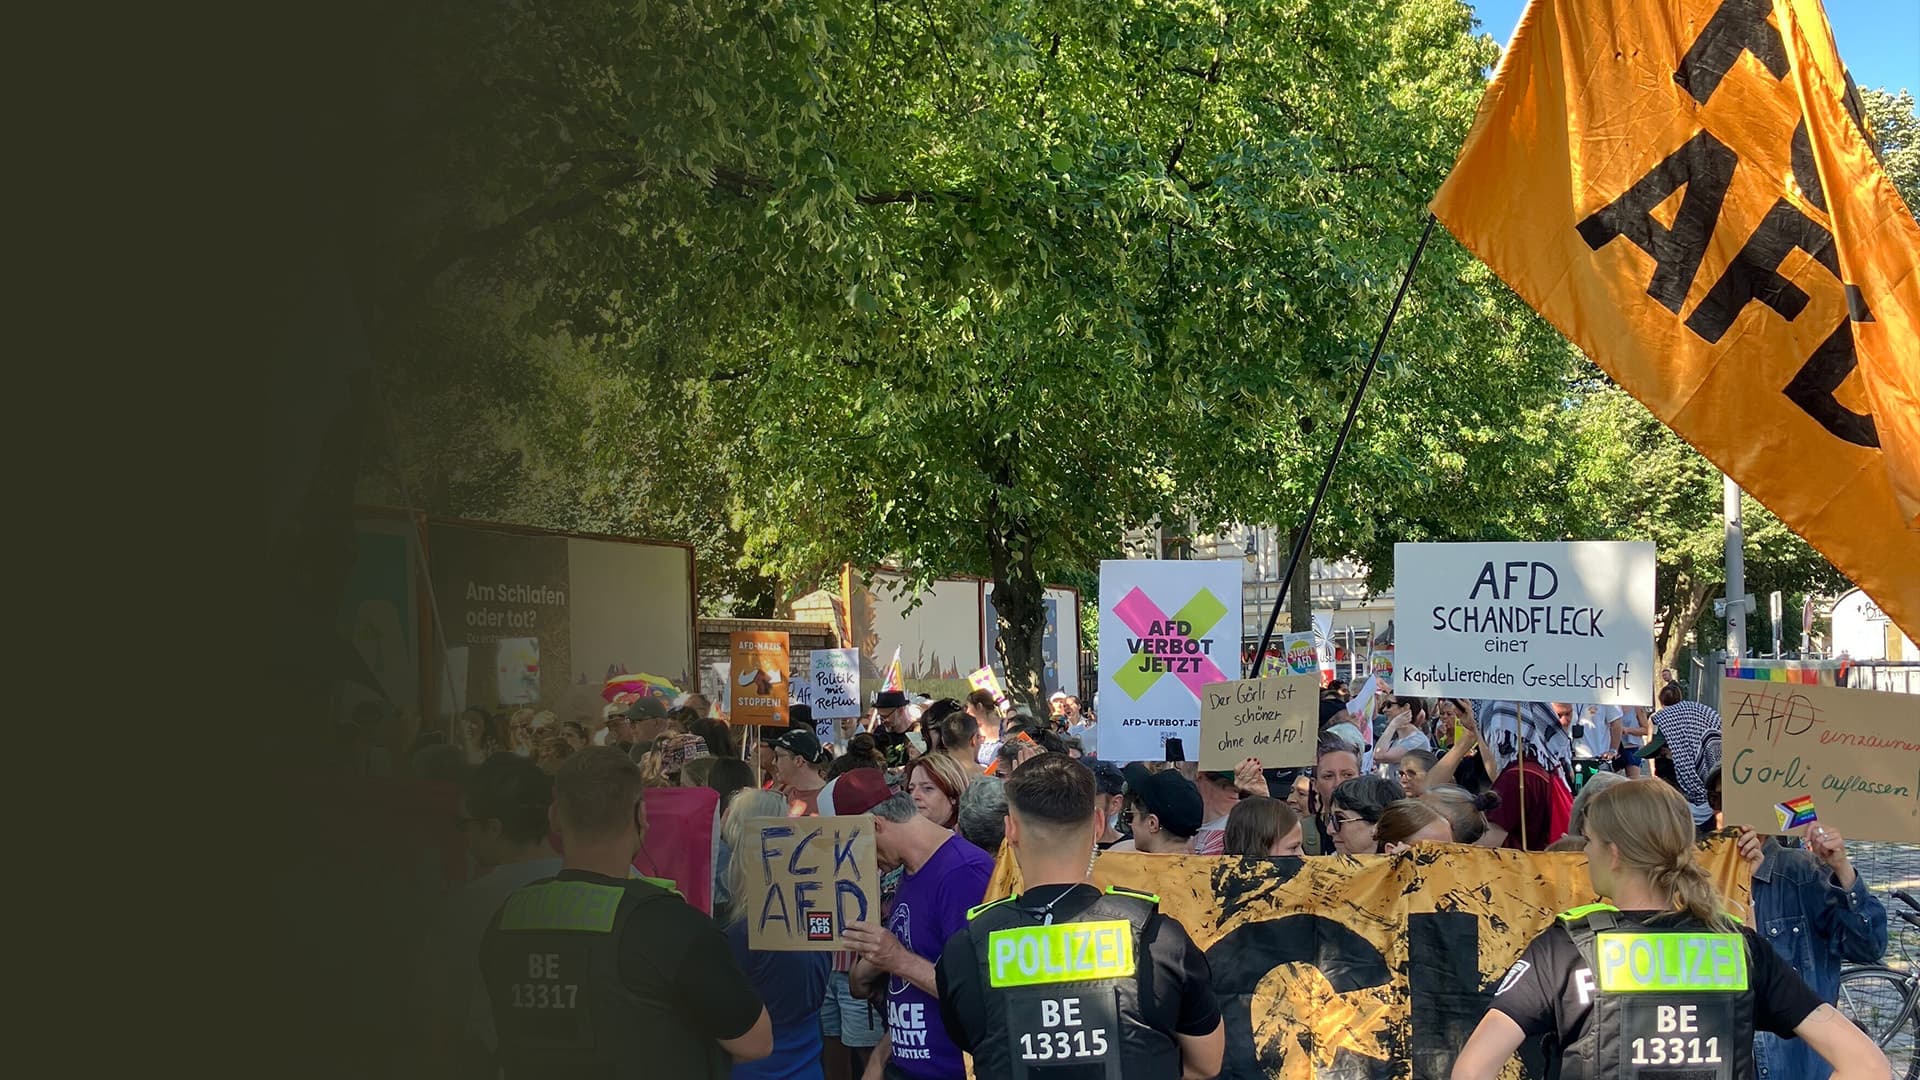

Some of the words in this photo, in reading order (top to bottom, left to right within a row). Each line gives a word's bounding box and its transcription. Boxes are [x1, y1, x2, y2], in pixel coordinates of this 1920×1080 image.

[1469, 561, 1559, 600] AFD
[466, 581, 494, 602] Am
[498, 582, 566, 606] Schlafen
[466, 608, 504, 628] oder
[507, 609, 537, 629] tot?
[1148, 620, 1192, 636] AFD
[1432, 605, 1605, 637] SCHANDFLECK
[1126, 639, 1214, 655] VERBOT
[1484, 637, 1529, 653] einer
[1138, 657, 1203, 673] JETZT
[1297, 655, 1313, 669] AFD
[815, 671, 855, 687] Politik
[825, 685, 845, 695] mit
[1210, 692, 1230, 710] Der
[1237, 683, 1266, 705] Görli
[1275, 687, 1297, 702] ist
[738, 697, 781, 707] STOPPEN!
[815, 697, 856, 710] Reflux
[1122, 718, 1201, 728] AFD-VERBOT.JE
[1233, 705, 1282, 726] schöner
[1218, 731, 1244, 752] ohne
[1253, 731, 1271, 746] die
[760, 825, 862, 885] FCK
[759, 879, 868, 937] AFD
[809, 917, 832, 926] FCK
[809, 926, 832, 935] AFD
[995, 927, 1126, 980] POLIZEI
[1604, 937, 1747, 987] POLIZEI
[529, 953, 561, 979] BE
[511, 983, 579, 1009] 13317
[1041, 997, 1083, 1028] BE
[1656, 1005, 1698, 1033] BE
[897, 1046, 931, 1060] JUSTICE
[1020, 1029, 1109, 1061] 13315
[1631, 1037, 1722, 1066] 13311
